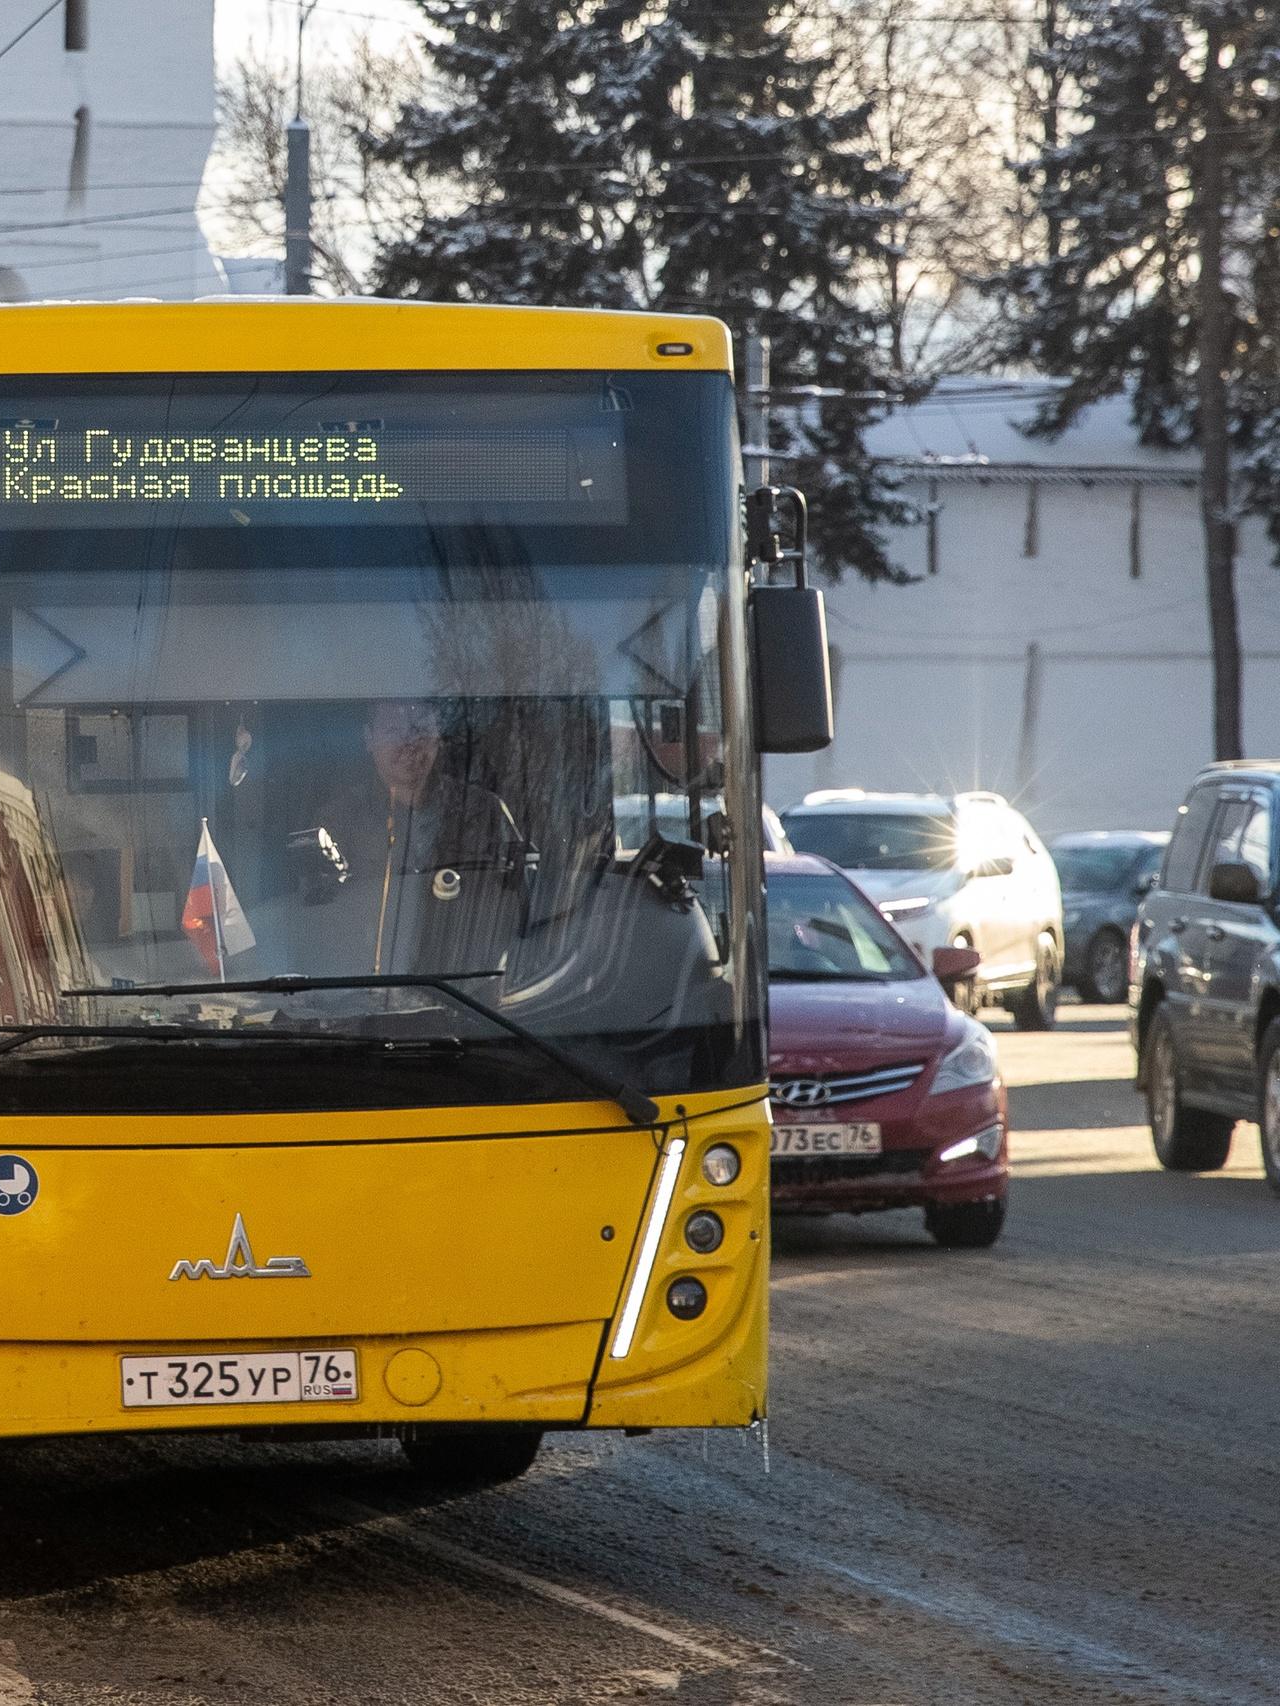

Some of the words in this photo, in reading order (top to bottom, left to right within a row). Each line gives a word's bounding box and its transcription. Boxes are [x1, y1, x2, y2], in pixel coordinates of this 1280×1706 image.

[4, 430, 56, 463] Ул
[85, 430, 377, 466] Гудованцева
[4, 466, 190, 504] Красная
[219, 474, 404, 503] площадь
[847, 1124, 873, 1143] 76
[303, 1355, 342, 1384] 76
[303, 1384, 332, 1397] RUS
